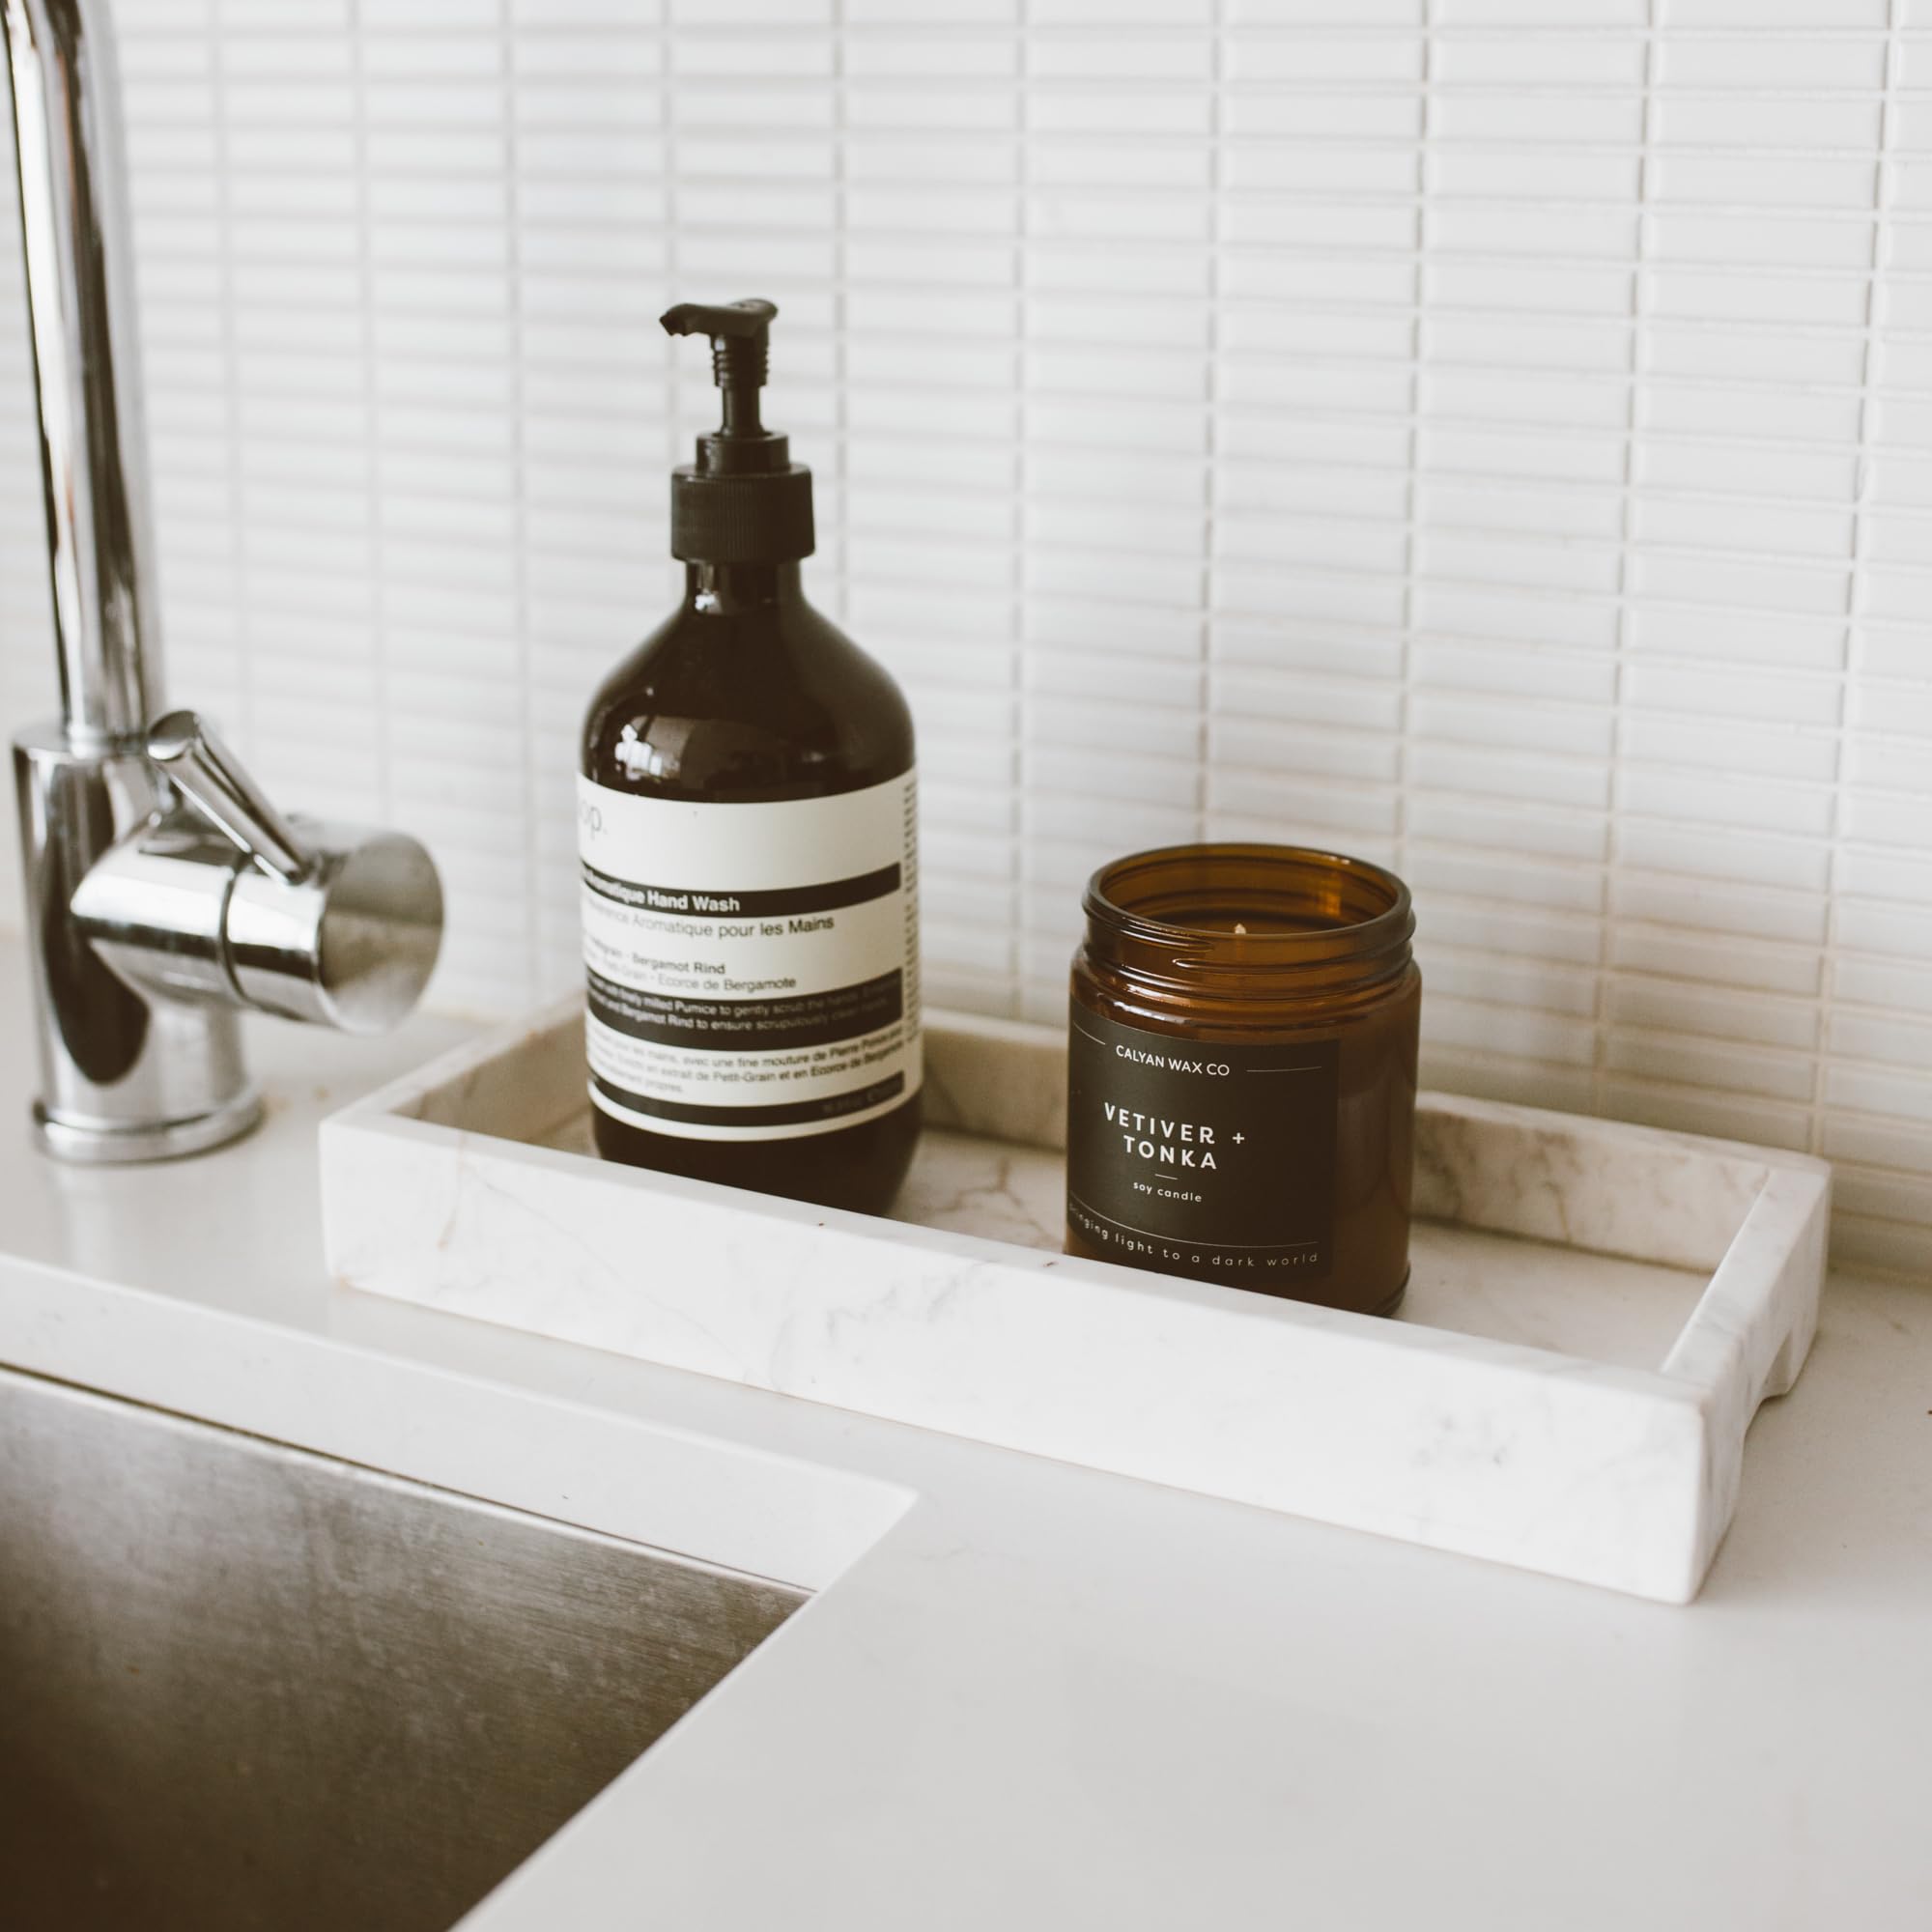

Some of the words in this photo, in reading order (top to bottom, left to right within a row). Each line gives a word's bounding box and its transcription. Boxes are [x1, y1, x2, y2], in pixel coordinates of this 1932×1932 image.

[646, 890, 689, 910] Hand
[693, 895, 740, 912] Wash
[634, 914, 713, 938] Aromatique
[719, 924, 754, 939] pour
[760, 922, 783, 935] les
[788, 917, 835, 934] Mains
[694, 961, 726, 975] Rind
[703, 978, 720, 990] de
[724, 976, 796, 993] Bergamote
[675, 1001, 717, 1015] Pumice
[719, 1005, 731, 1015] to
[734, 1004, 769, 1018] gently
[668, 1014, 695, 1029] Rind
[696, 1019, 710, 1030] to
[711, 1020, 753, 1031] ensure
[812, 1049, 828, 1061] de
[1116, 1044, 1165, 1068] CALYAN
[1168, 1057, 1203, 1075] WAX
[1207, 1063, 1231, 1077] CO
[780, 1069, 790, 1081] et
[793, 1069, 809, 1080] en
[1104, 1101, 1216, 1145] VETIVER
[1122, 1134, 1217, 1170] TONKA
[1133, 1181, 1152, 1196] soy
[1157, 1185, 1203, 1203] candle
[1115, 1233, 1153, 1255] light
[1162, 1248, 1180, 1261] to
[1191, 1254, 1201, 1264] a
[1212, 1253, 1255, 1267] dark
[1266, 1252, 1319, 1267] world
